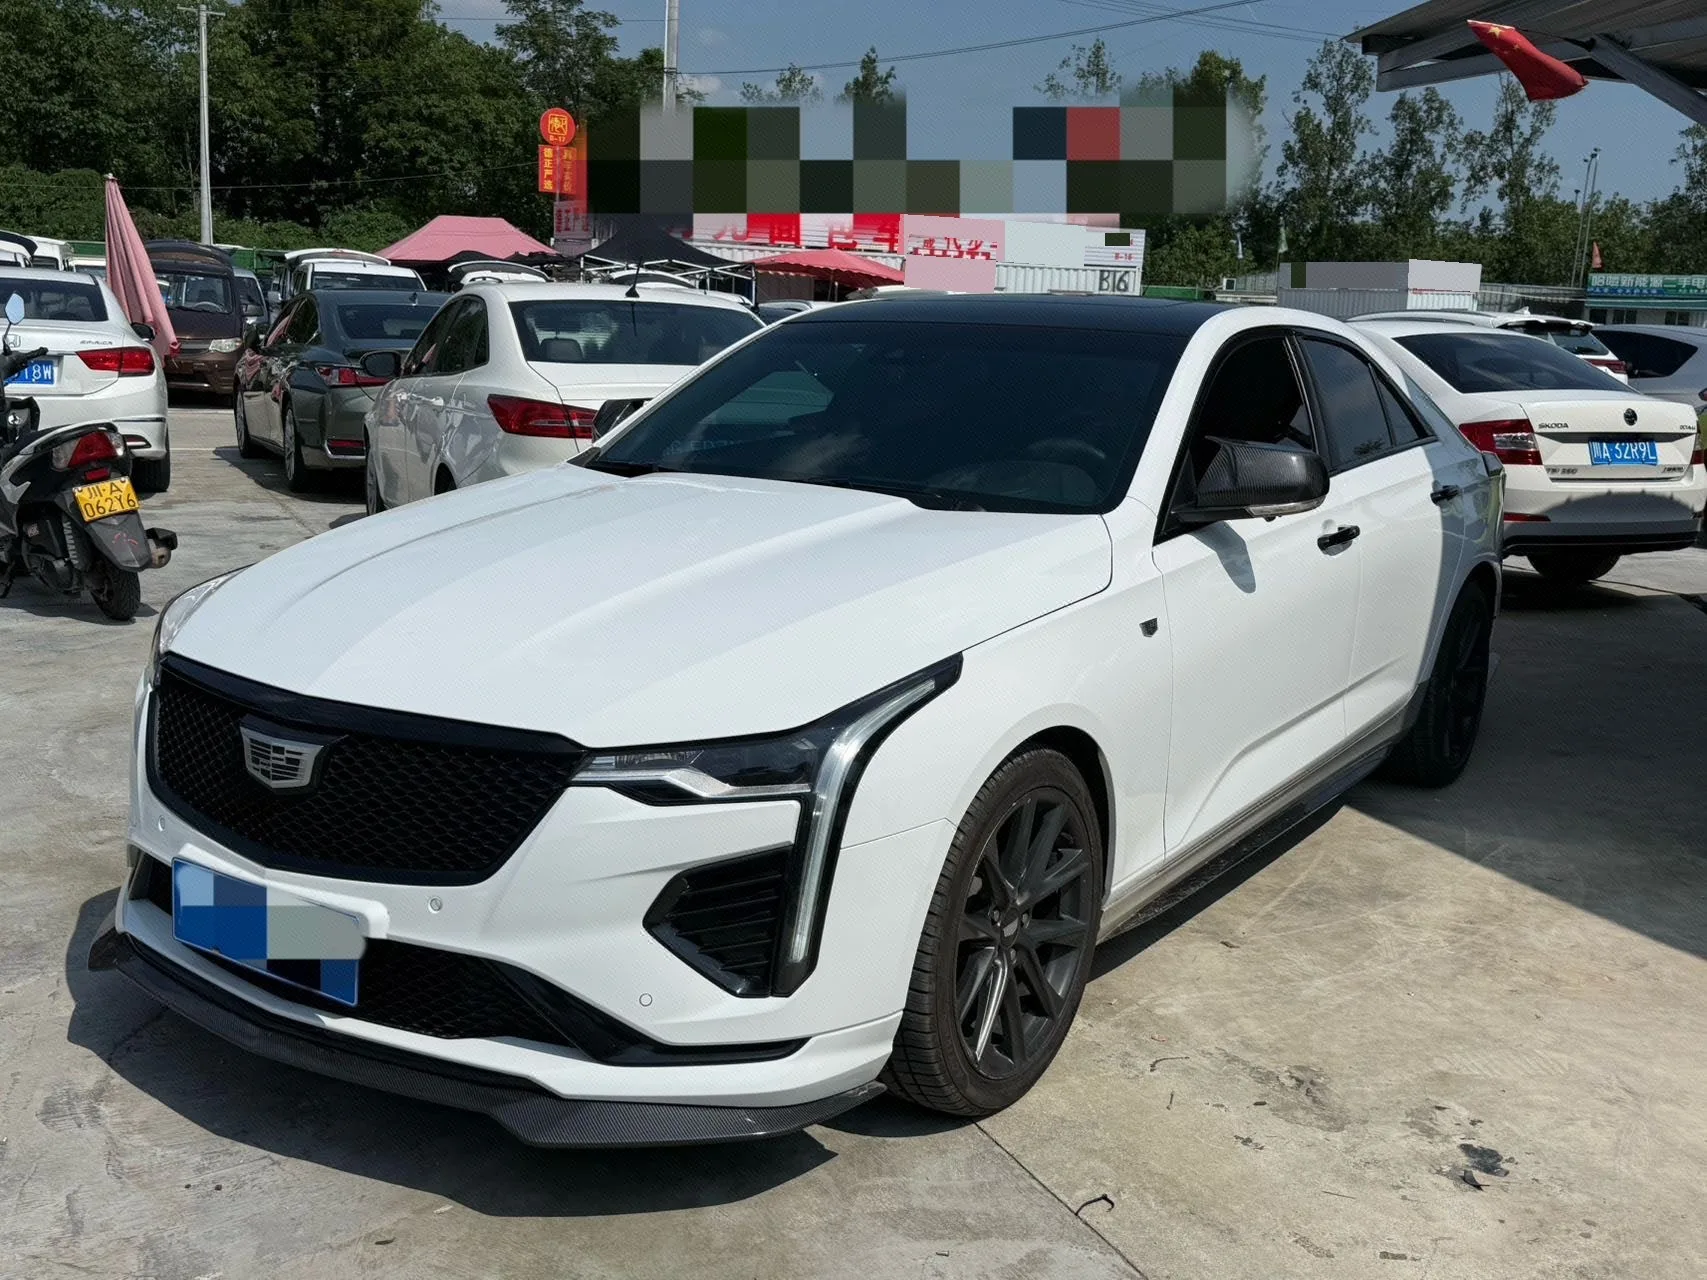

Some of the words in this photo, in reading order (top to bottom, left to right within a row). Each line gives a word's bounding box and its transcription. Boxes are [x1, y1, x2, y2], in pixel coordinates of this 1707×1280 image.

[1100, 270, 1129, 292] B16
[84, 493, 136, 518] 062Y6
[63, 521, 79, 565] YAMAHA
